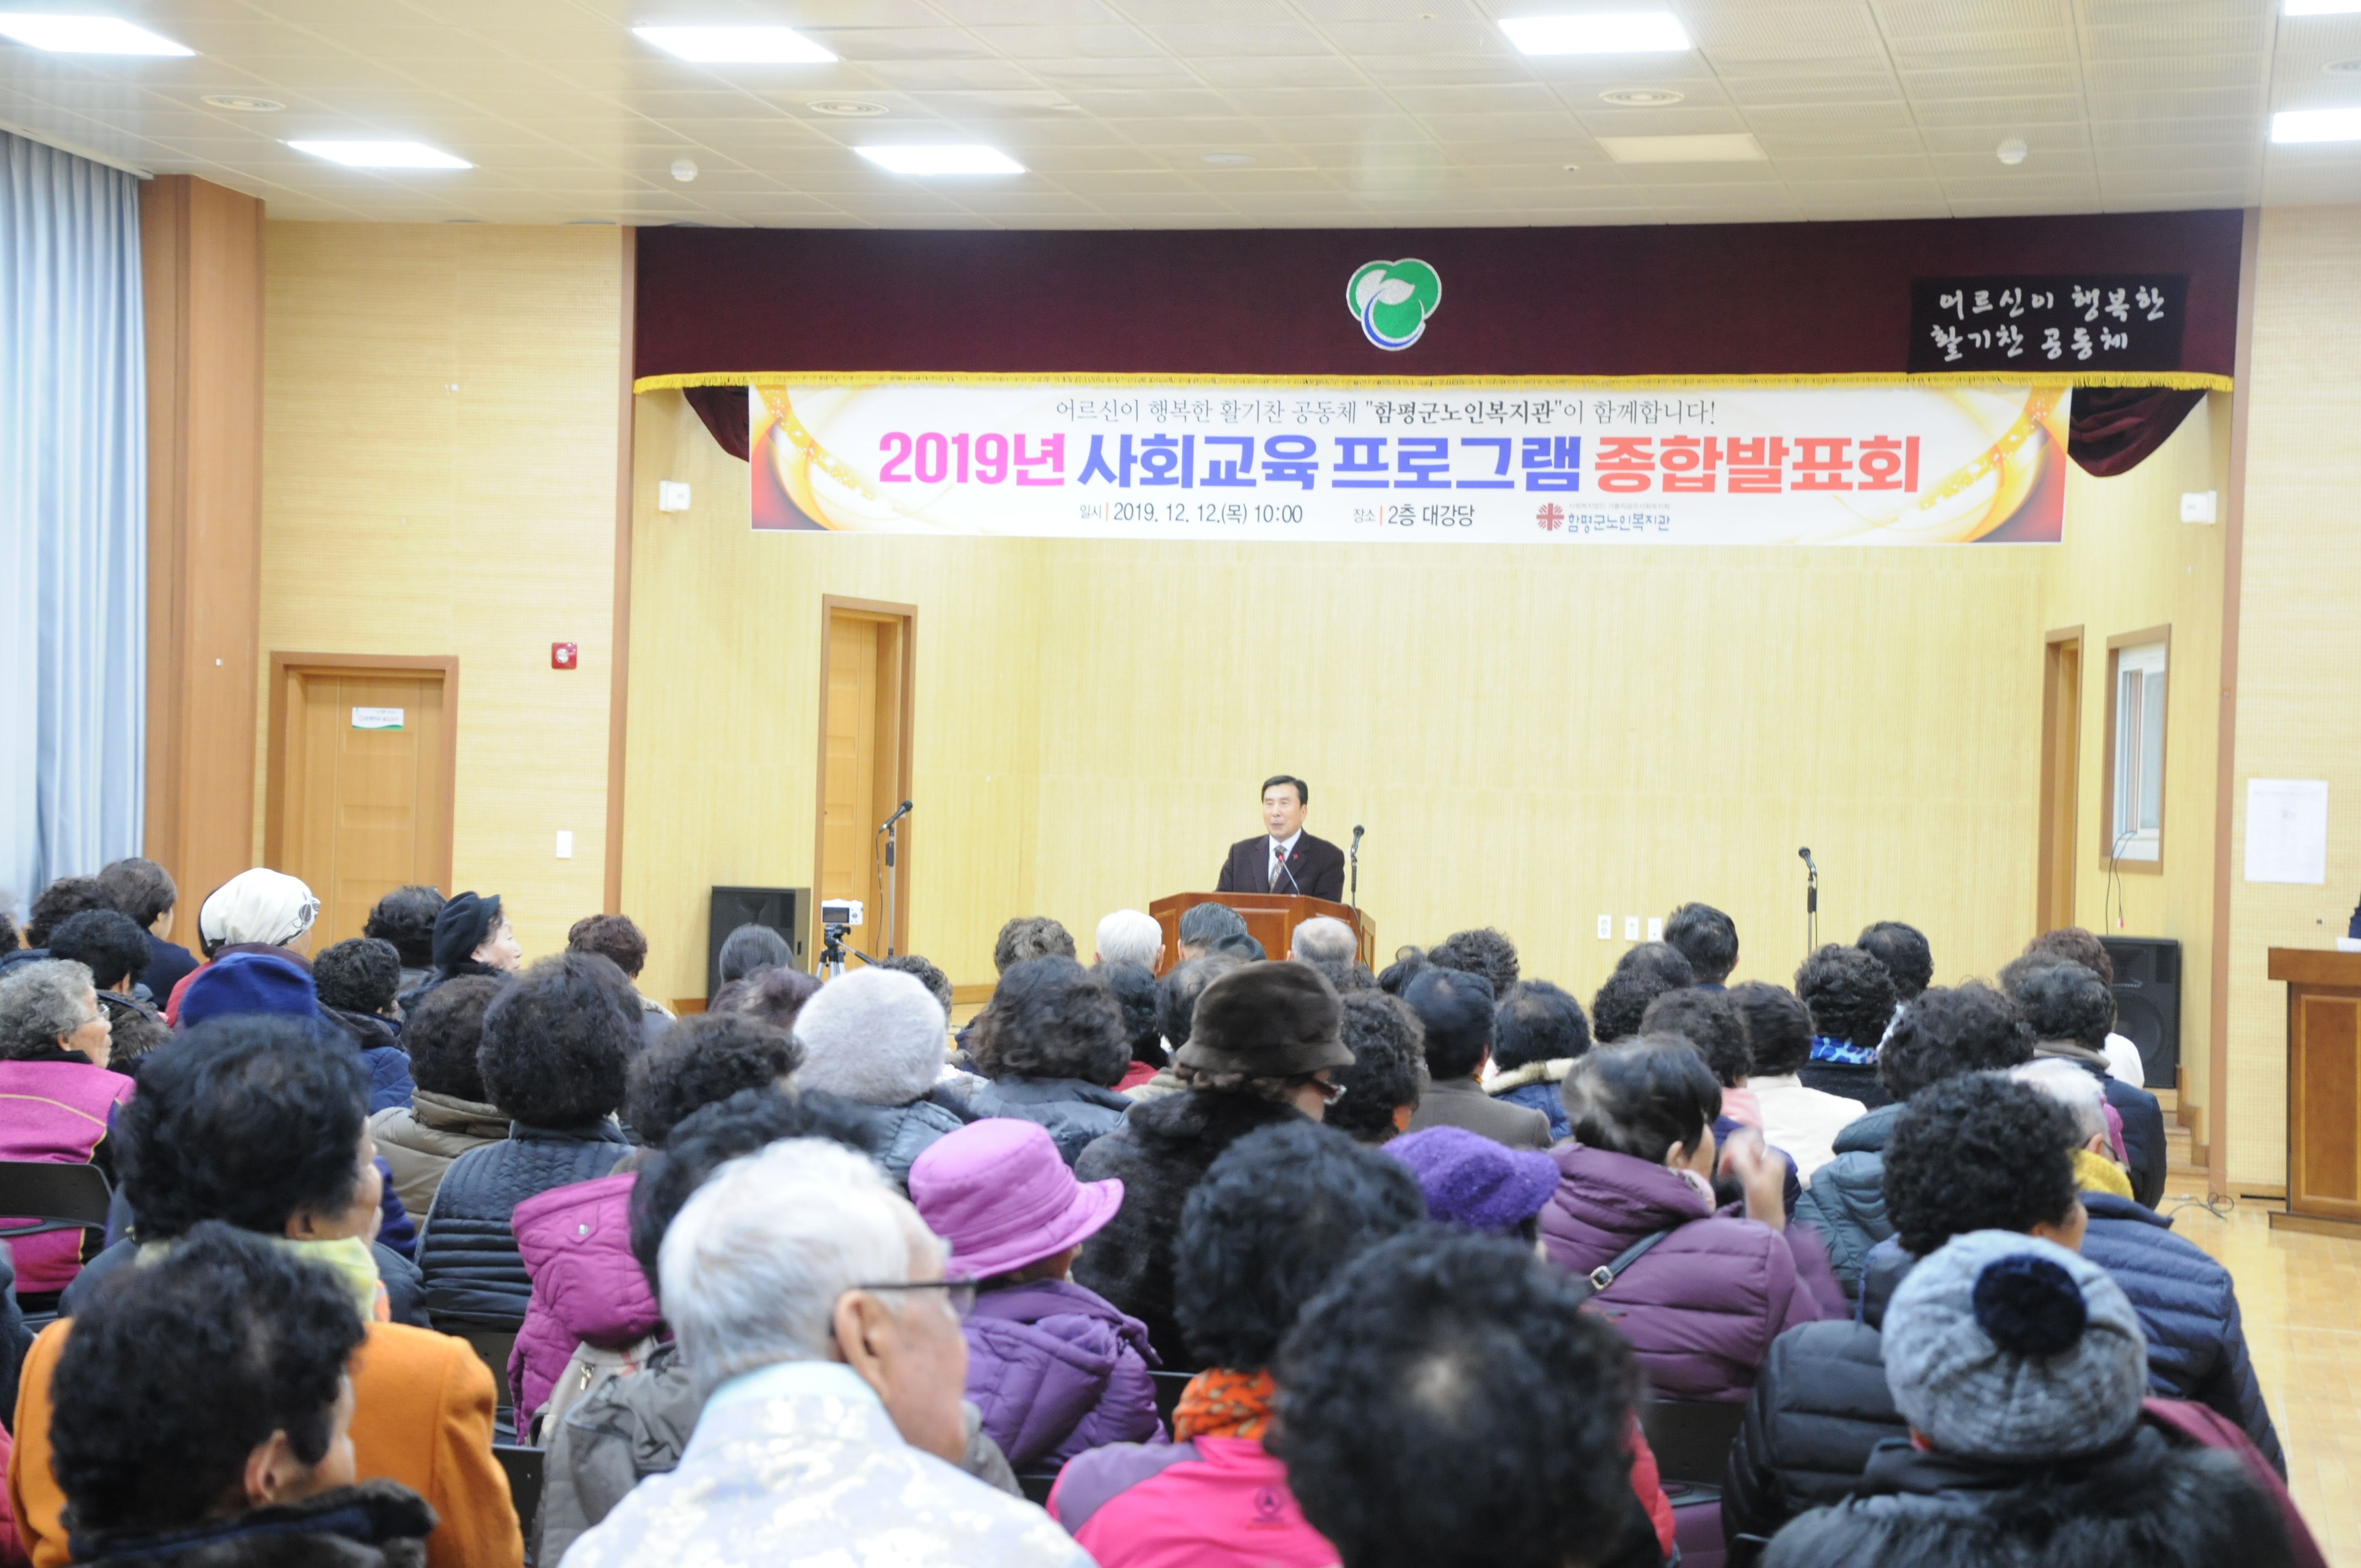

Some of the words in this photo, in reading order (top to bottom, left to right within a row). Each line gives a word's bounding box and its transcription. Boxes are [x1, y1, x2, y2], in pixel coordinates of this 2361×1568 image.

[1939, 286, 2055, 320] 어르신이
[2071, 284, 2165, 322] 행복한
[1930, 324, 2025, 363] 활기찬
[2041, 326, 2129, 361] 공동체
[1056, 398, 1139, 423] 어르신이
[1149, 399, 1214, 424] 행복한
[1220, 399, 1285, 424] 활기찬
[1292, 400, 1357, 425] 공동체
[1593, 399, 1716, 426] 함께합니다!
[879, 431, 1066, 487] 2019년
[1076, 432, 1319, 491] 사회교육
[1331, 435, 1582, 493] 프로그램
[1594, 434, 1922, 494] 종합발표회
[1079, 504, 1102, 520] 일시
[1254, 504, 1303, 524] 10:00
[1353, 507, 1376, 524] 장소
[1388, 503, 1417, 527] 2층
[1422, 504, 1476, 528] 대강당
[1568, 511, 1672, 535] 함평군노인복지관
